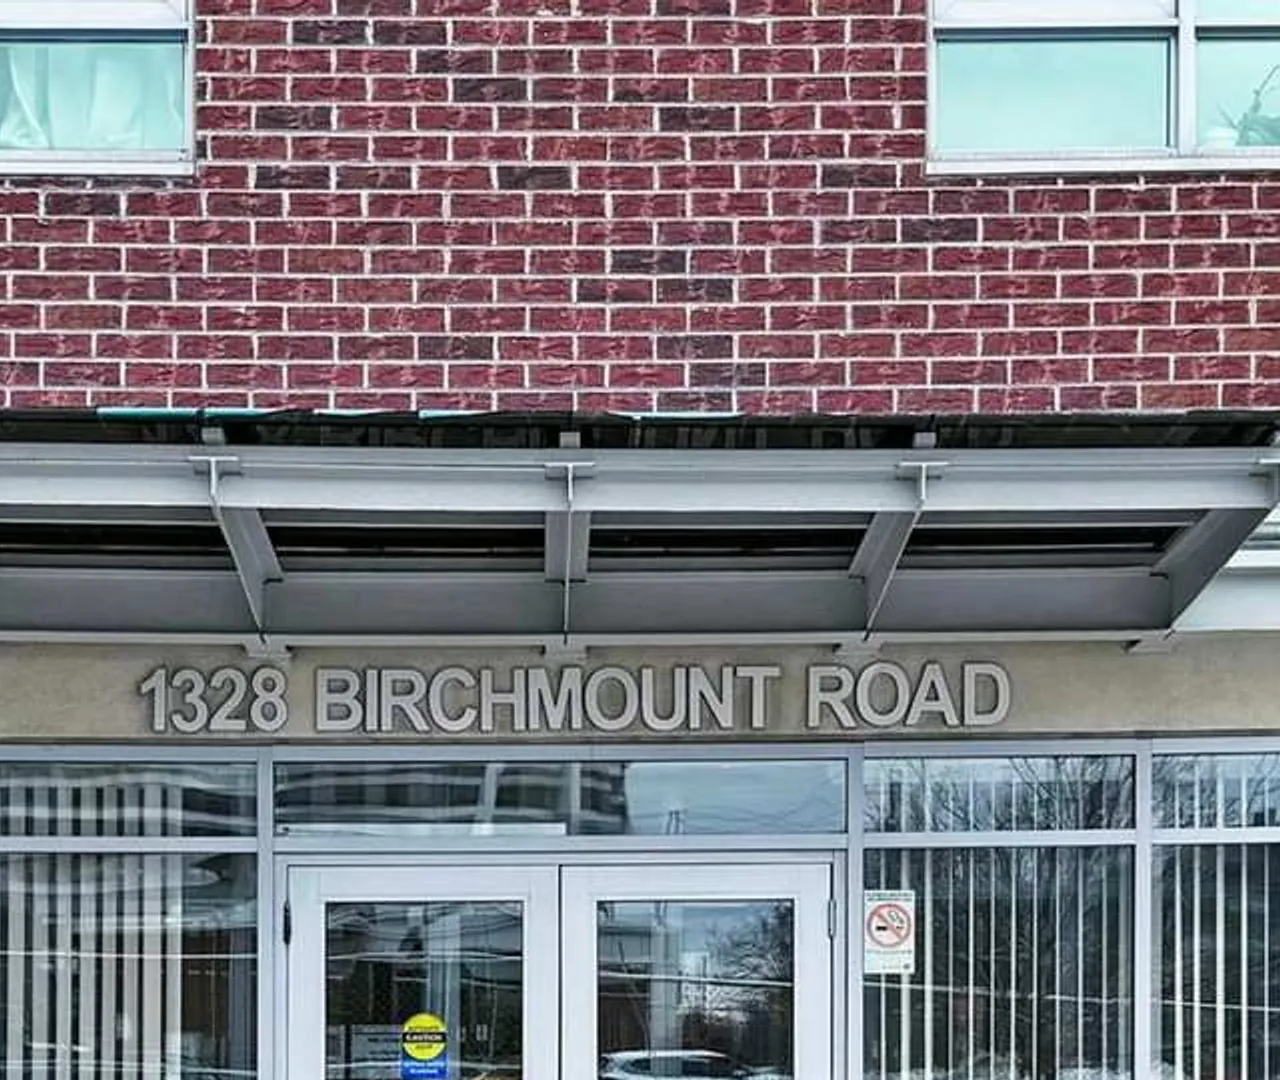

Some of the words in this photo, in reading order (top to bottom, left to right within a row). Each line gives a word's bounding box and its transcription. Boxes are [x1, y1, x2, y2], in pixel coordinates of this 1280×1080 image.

[138, 665, 289, 733] 1328
[315, 664, 781, 732] BIRCHMOUNT
[807, 661, 1011, 729] ROAD
